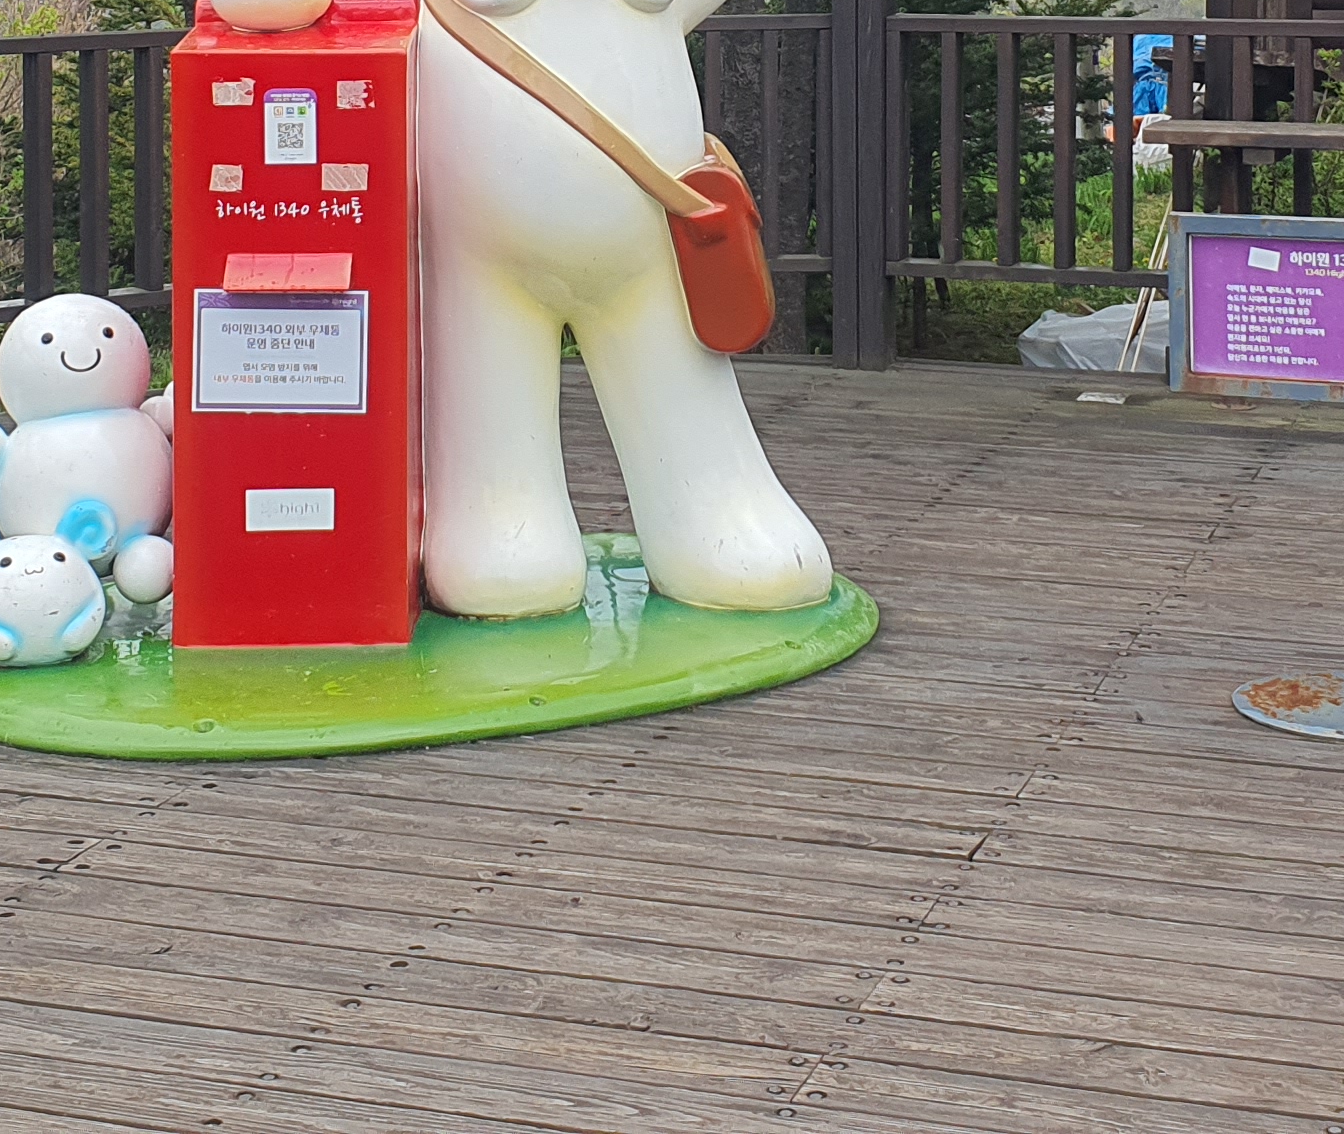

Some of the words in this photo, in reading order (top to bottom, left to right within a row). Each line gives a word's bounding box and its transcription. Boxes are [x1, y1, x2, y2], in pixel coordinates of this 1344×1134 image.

[216, 199, 266, 220] 하이원
[274, 201, 310, 218] 1340
[317, 196, 364, 224] 우체통
[1289, 251, 1330, 267] 하이원
[1305, 268, 1325, 277] 1340
[221, 323, 282, 335] 하이원1340
[247, 337, 267, 349] 운영
[271, 338, 291, 349] 중단
[294, 337, 316, 349] 안내
